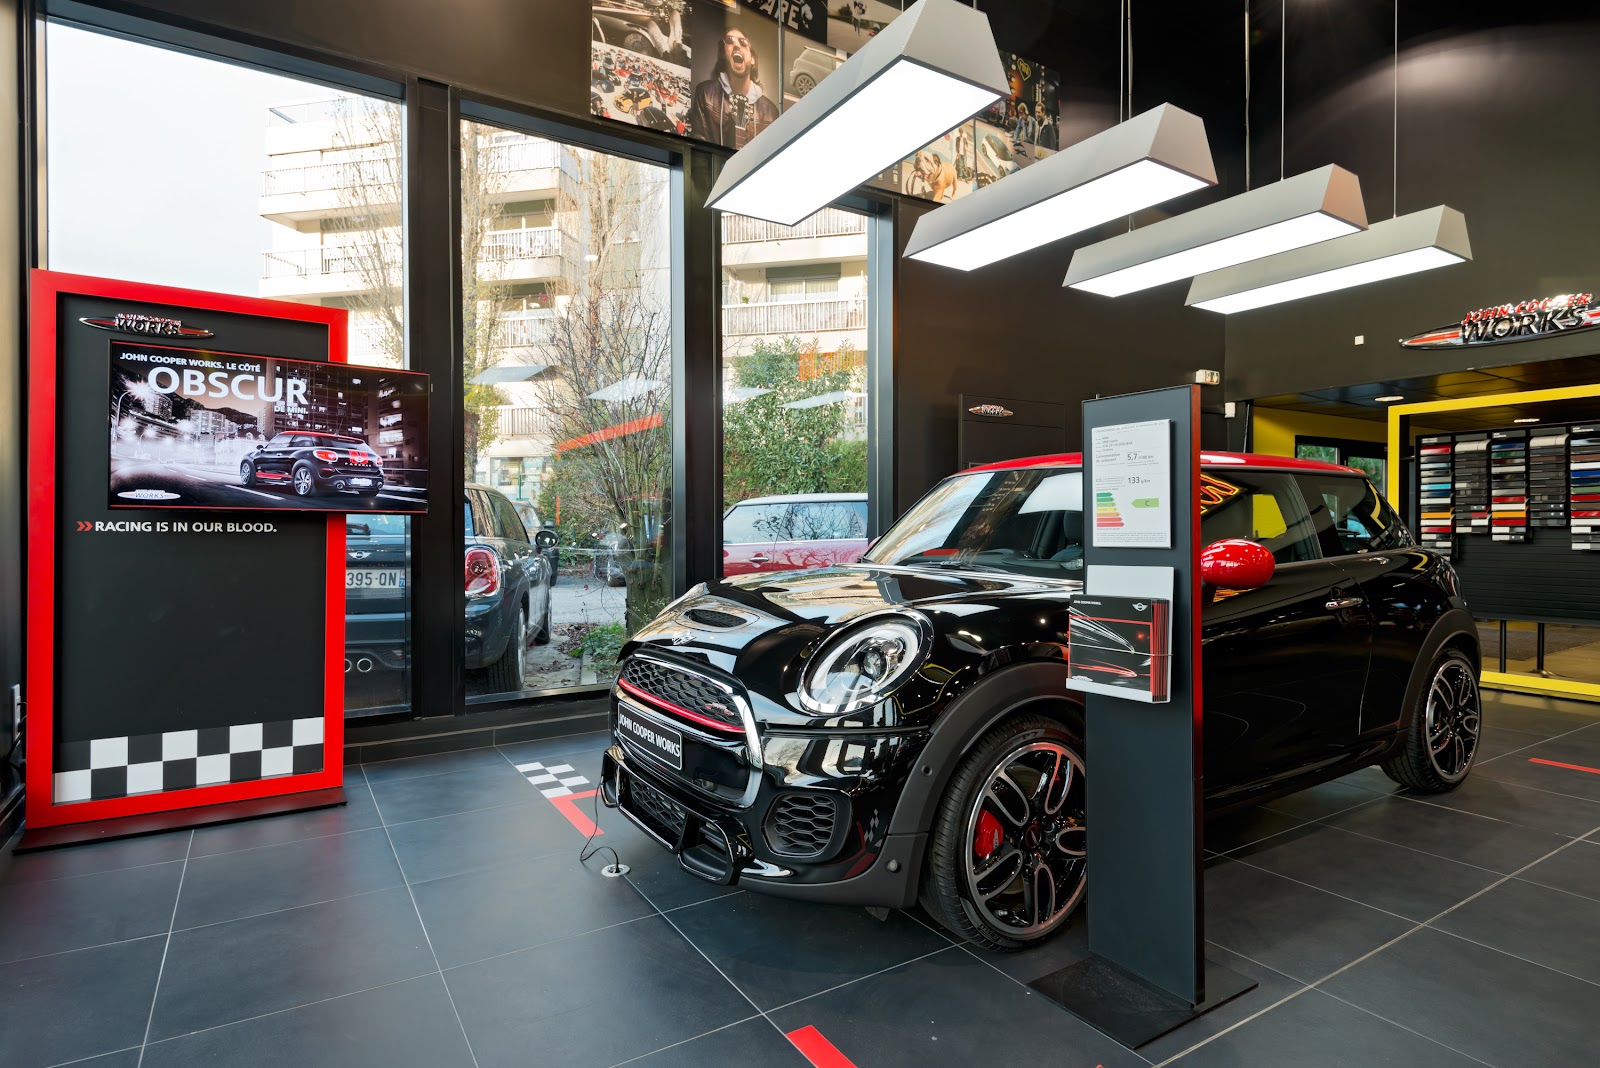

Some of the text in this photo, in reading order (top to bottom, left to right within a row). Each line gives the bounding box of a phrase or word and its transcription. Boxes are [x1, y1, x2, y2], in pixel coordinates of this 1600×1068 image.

[1462, 306, 1587, 344] WORKS
[120, 352, 261, 373] JOHN COOPER WORKS. LE CÔTÉ
[147, 366, 309, 405] OBSCUR
[274, 405, 286, 413] DE
[1127, 453, 1138, 461] 5,7
[1128, 476, 1140, 484] 133
[95, 521, 277, 533] RACING IS IN OUR BLOOD.
[619, 713, 680, 758] JOHN COOPER WORKS
